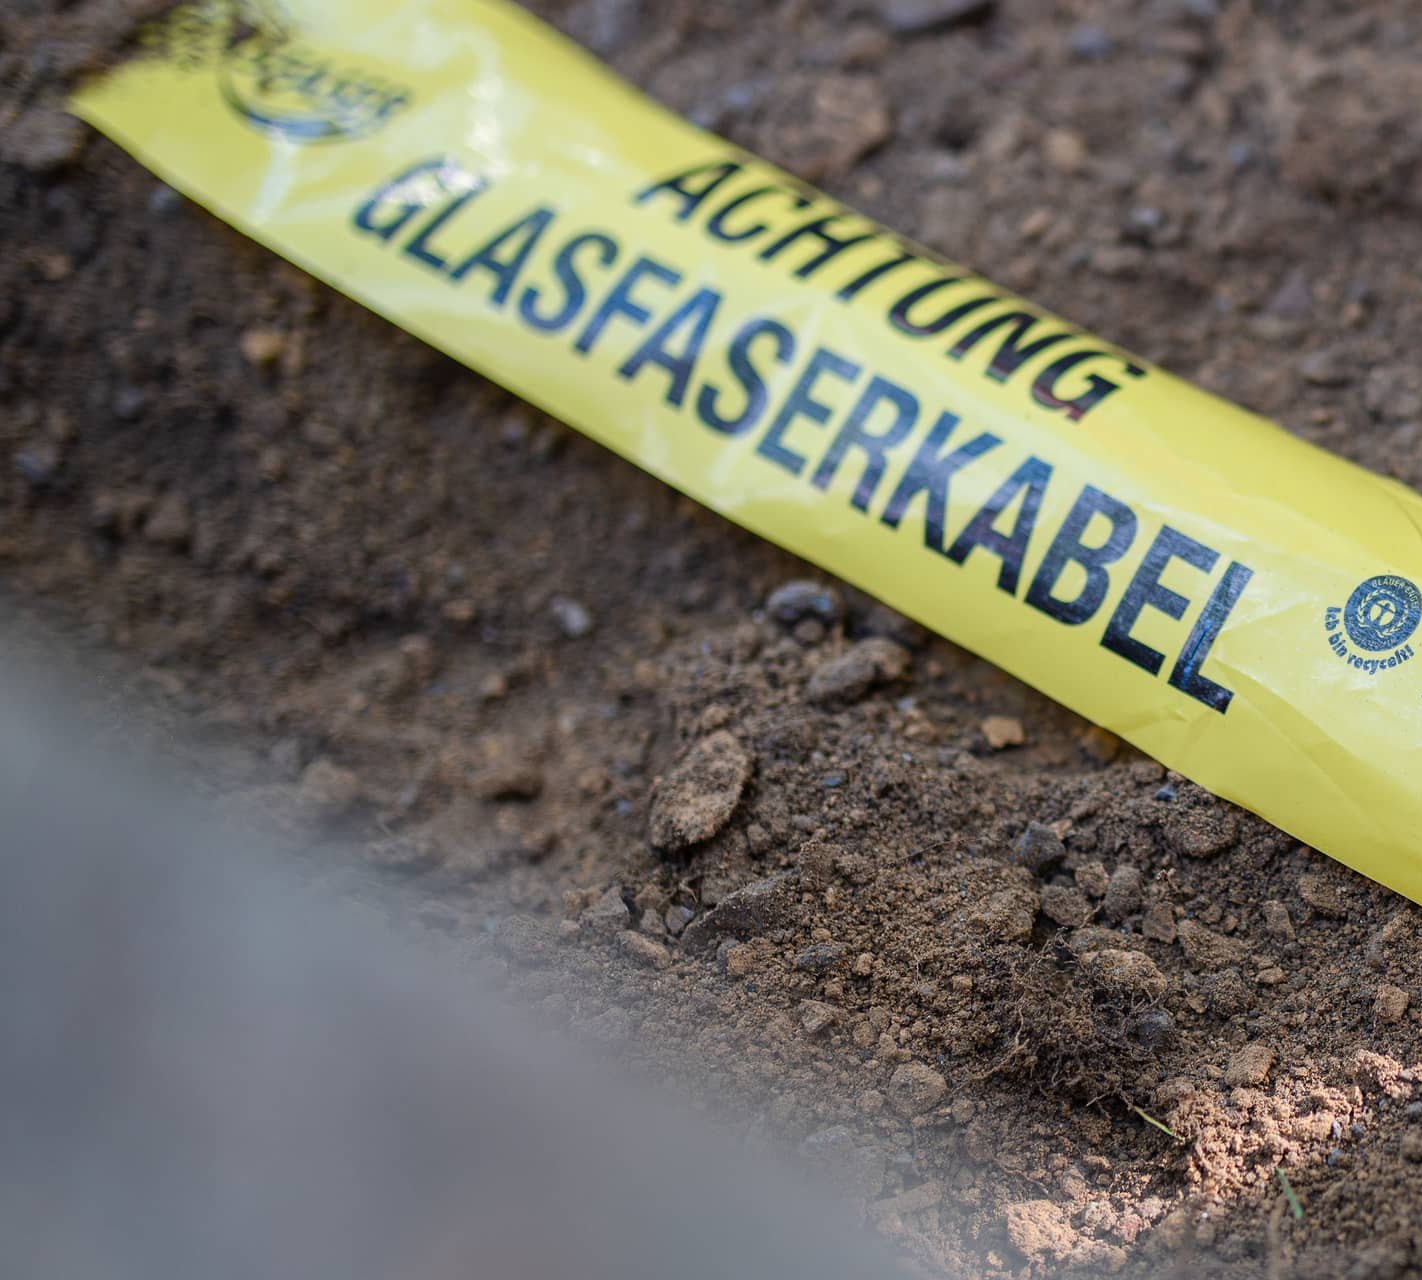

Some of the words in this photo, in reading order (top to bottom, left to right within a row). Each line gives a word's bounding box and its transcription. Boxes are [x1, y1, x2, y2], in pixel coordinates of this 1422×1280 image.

[636, 160, 1148, 422] ACHTUNG
[353, 157, 1255, 716] GLASFASERKABEL
[1328, 632, 1347, 657] bin
